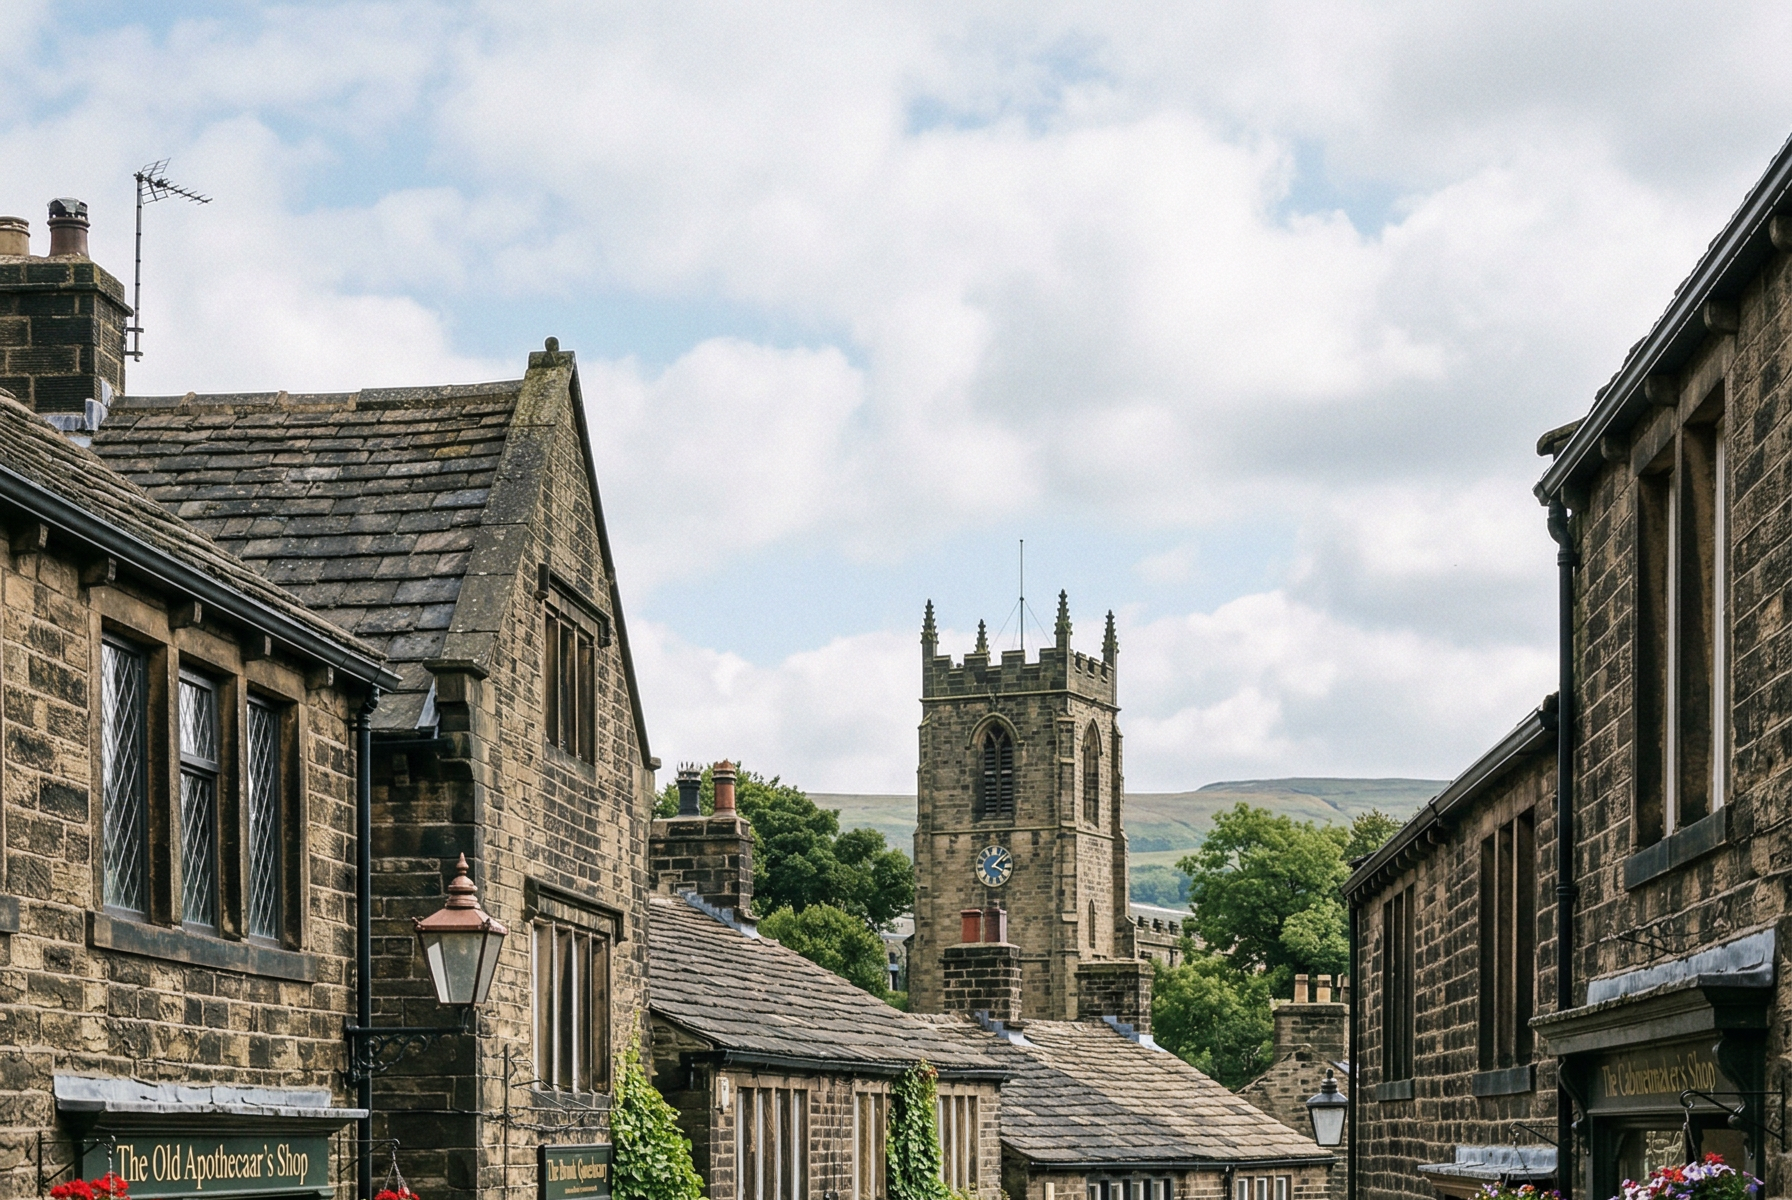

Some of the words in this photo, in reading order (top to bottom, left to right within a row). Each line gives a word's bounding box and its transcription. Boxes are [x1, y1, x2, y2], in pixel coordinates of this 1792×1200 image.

[1602, 1065, 1618, 1098] The
[1687, 1051, 1716, 1096] Shop
[116, 1144, 149, 1182] The
[152, 1144, 182, 1182] Old
[277, 1143, 309, 1186] Shop
